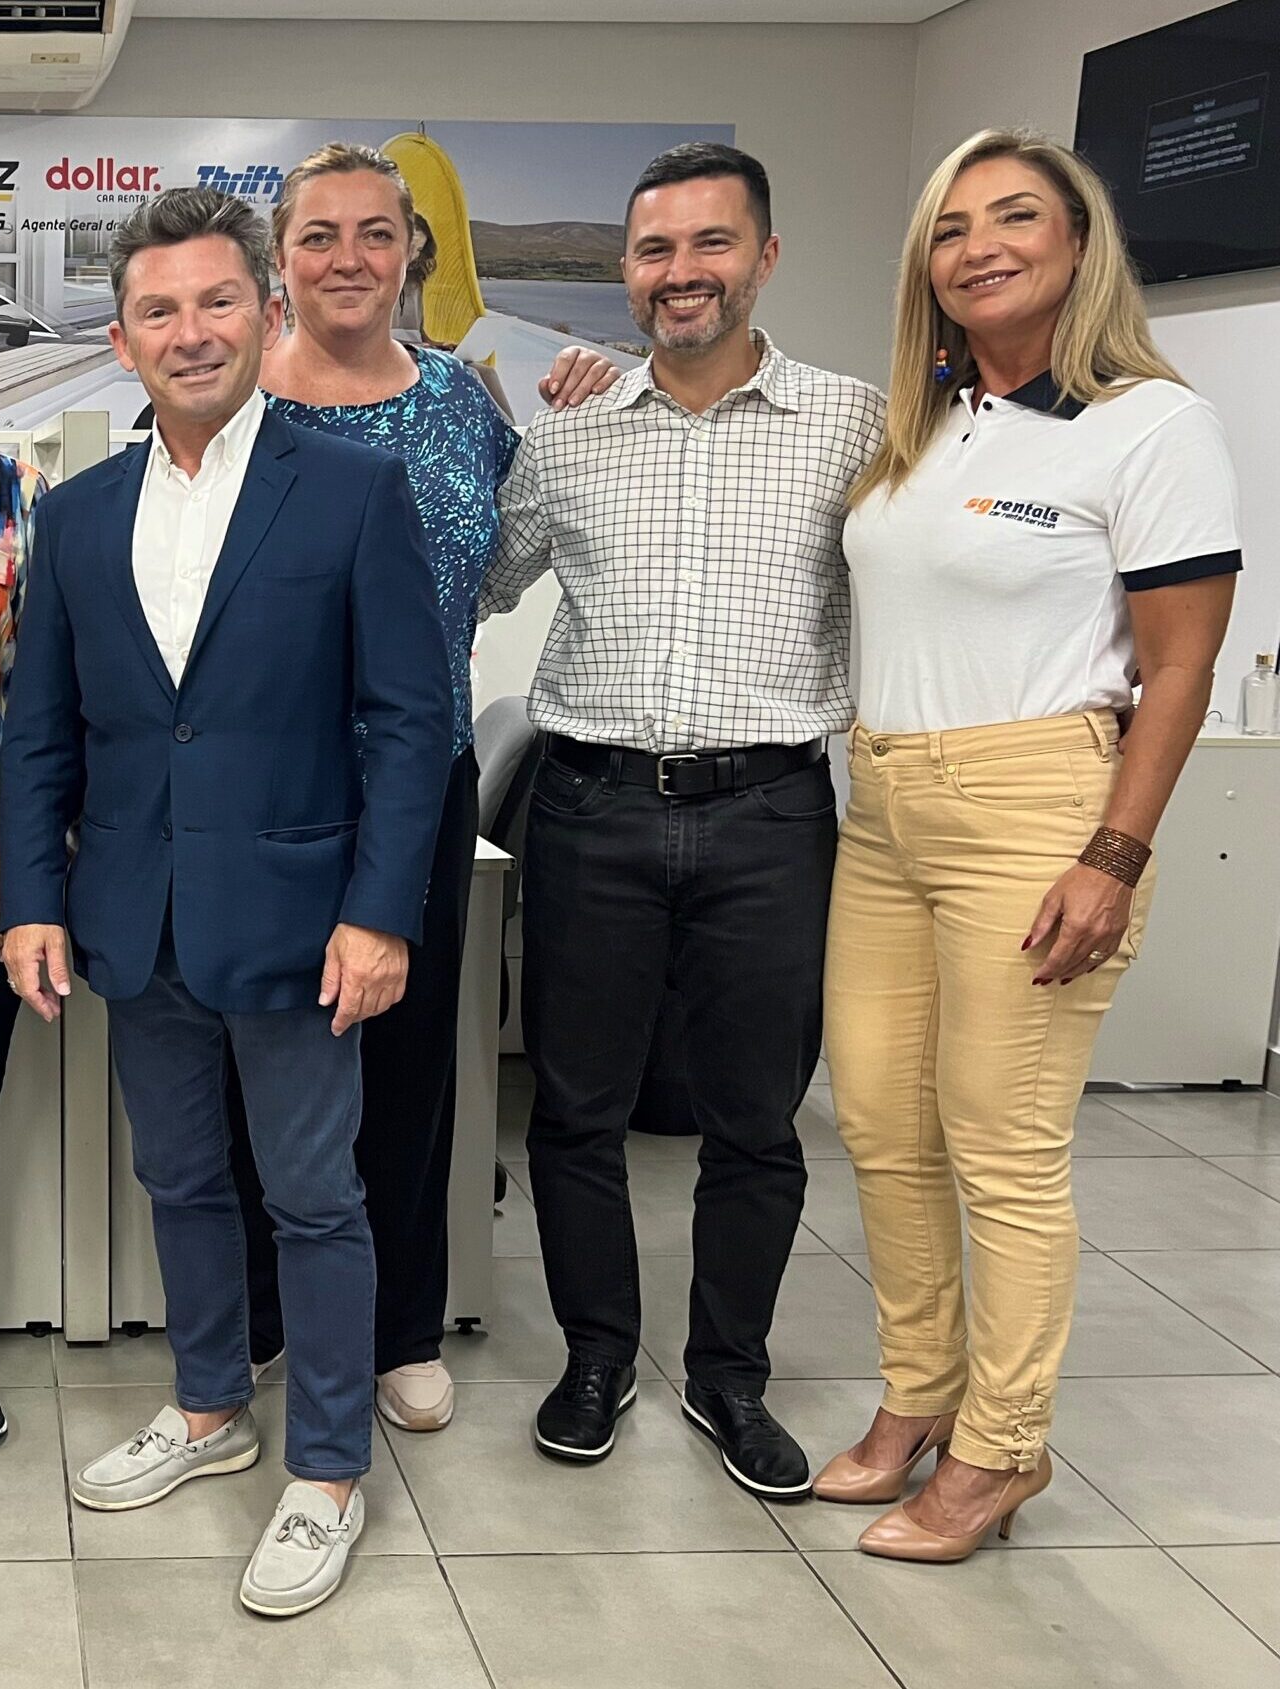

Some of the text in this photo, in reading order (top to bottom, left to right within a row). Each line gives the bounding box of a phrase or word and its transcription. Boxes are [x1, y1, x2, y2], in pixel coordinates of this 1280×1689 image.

[197, 165, 285, 204] Thrifty
[96, 194, 115, 203] CAR
[21, 218, 66, 233] Agente
[69, 218, 103, 232] Geral
[1001, 512, 1026, 522] rental
[1024, 517, 1056, 529] services
